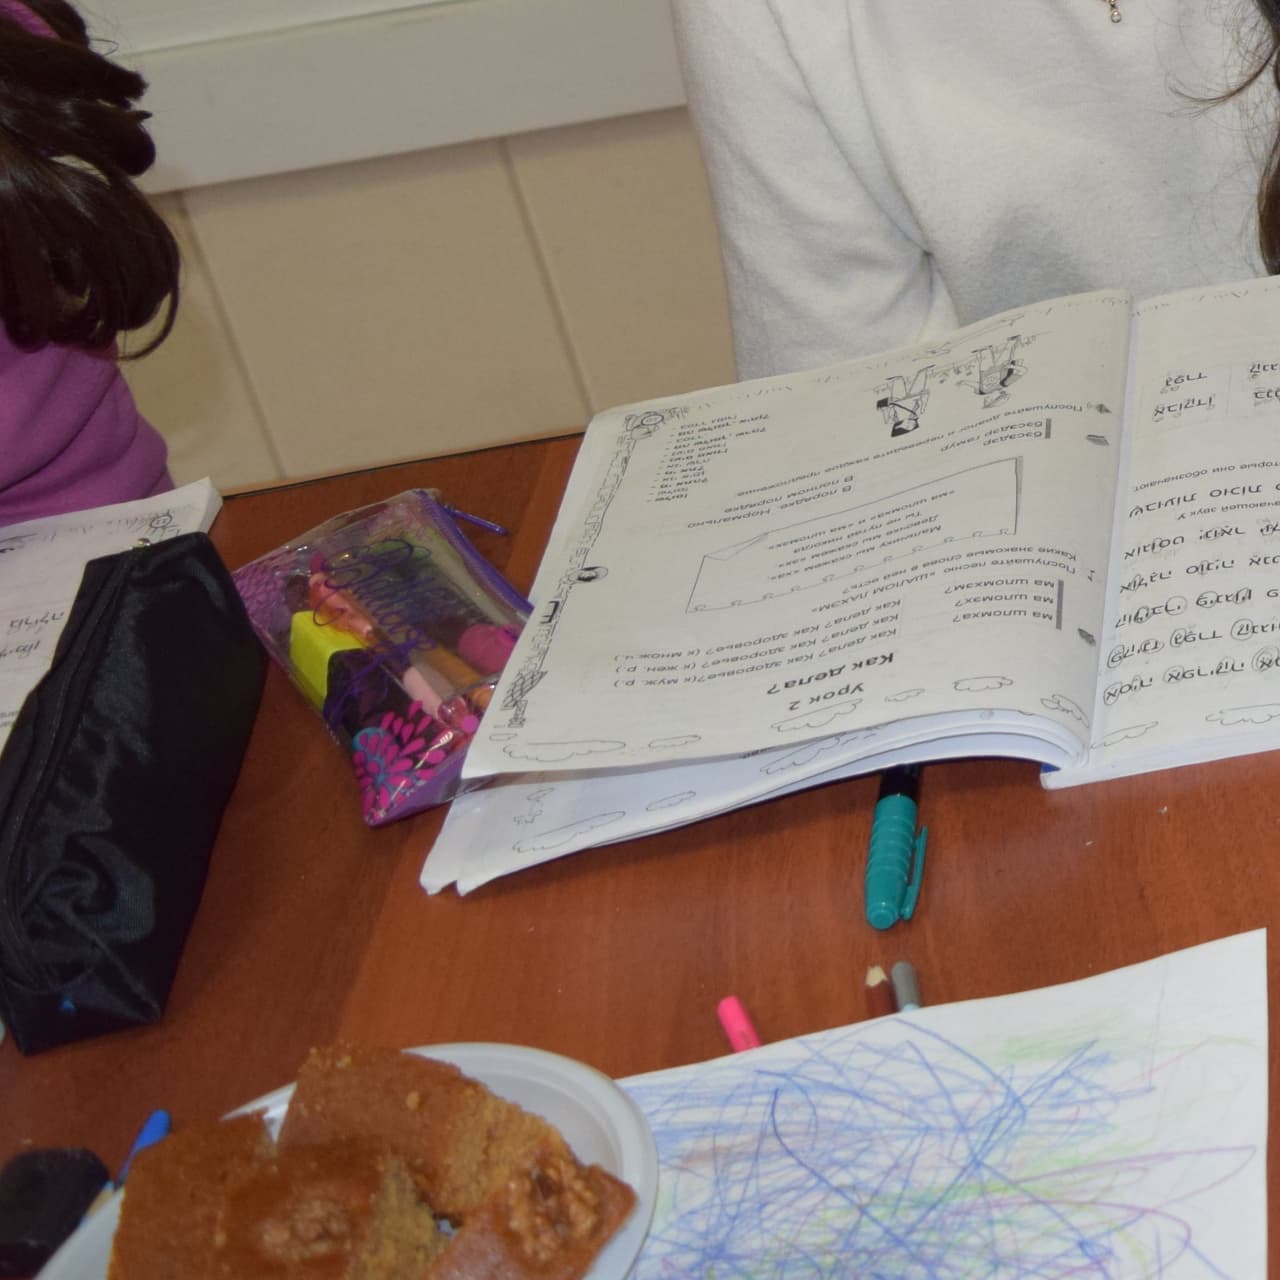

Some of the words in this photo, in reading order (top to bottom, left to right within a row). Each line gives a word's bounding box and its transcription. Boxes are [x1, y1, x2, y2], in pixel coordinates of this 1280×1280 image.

[942, 577, 1029, 595] шломхэм?
[1032, 578, 1055, 589] ма
[953, 592, 1028, 608] шломэх?
[1031, 593, 1054, 605] ма
[951, 608, 1027, 623] шломха?
[1031, 609, 1053, 621] ма
[850, 651, 894, 672] Как
[765, 663, 847, 696] дела?
[807, 681, 864, 705] Урок
[787, 698, 801, 712] 2
